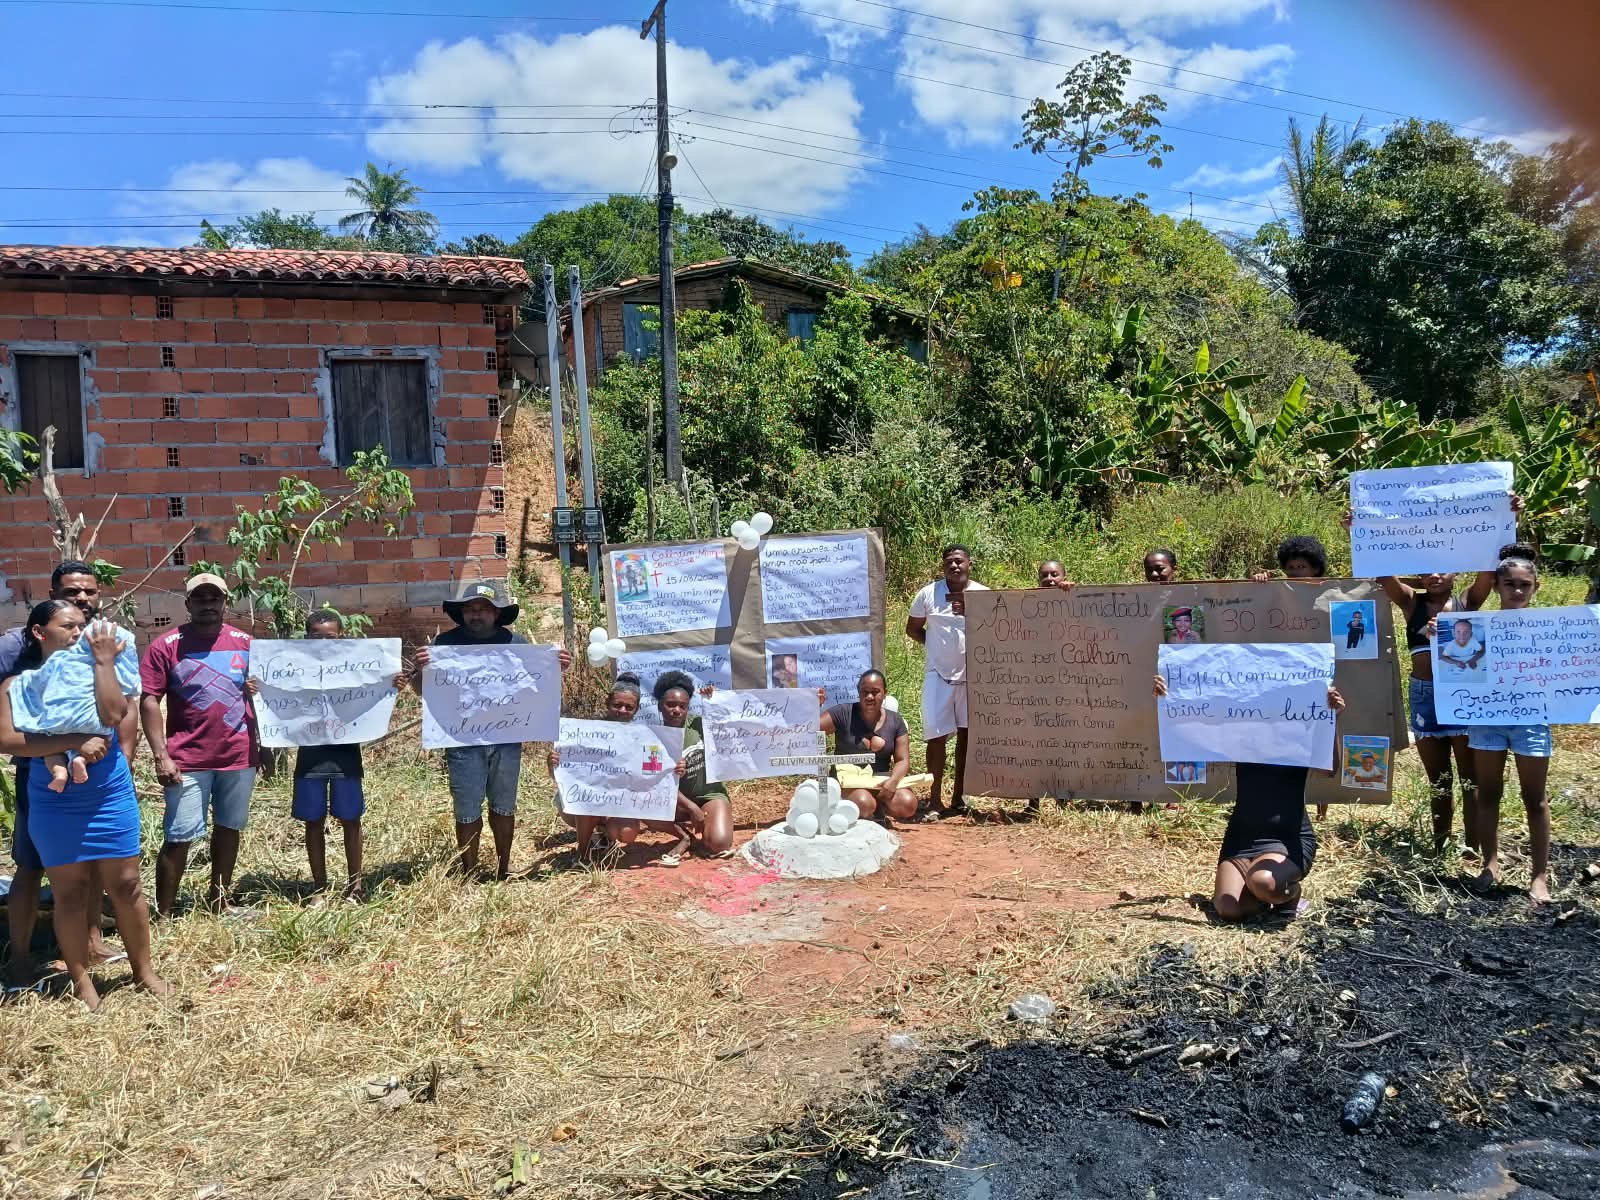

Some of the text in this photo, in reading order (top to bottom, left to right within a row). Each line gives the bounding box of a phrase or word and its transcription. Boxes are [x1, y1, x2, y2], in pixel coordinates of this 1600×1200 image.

[1354, 527, 1366, 539] O
[1430, 523, 1447, 535] de
[1450, 521, 1497, 535] vocês
[833, 543, 844, 552] de
[847, 544, 854, 552] 4
[1368, 541, 1414, 551] nossa
[1415, 537, 1455, 551] dor!
[1020, 593, 1150, 619] Comunidade
[1223, 608, 1256, 633] 30
[1530, 630, 1598, 647] pedimos
[974, 645, 1025, 665] Clama
[1031, 650, 1057, 668] por
[1490, 645, 1542, 659] apenas
[1544, 646, 1553, 655] o
[259, 655, 382, 683] Vocês podem
[1034, 673, 1056, 685] as
[1450, 687, 1547, 708] Protejam
[1224, 706, 1271, 719] em
[1453, 702, 1549, 721] Crianças!
